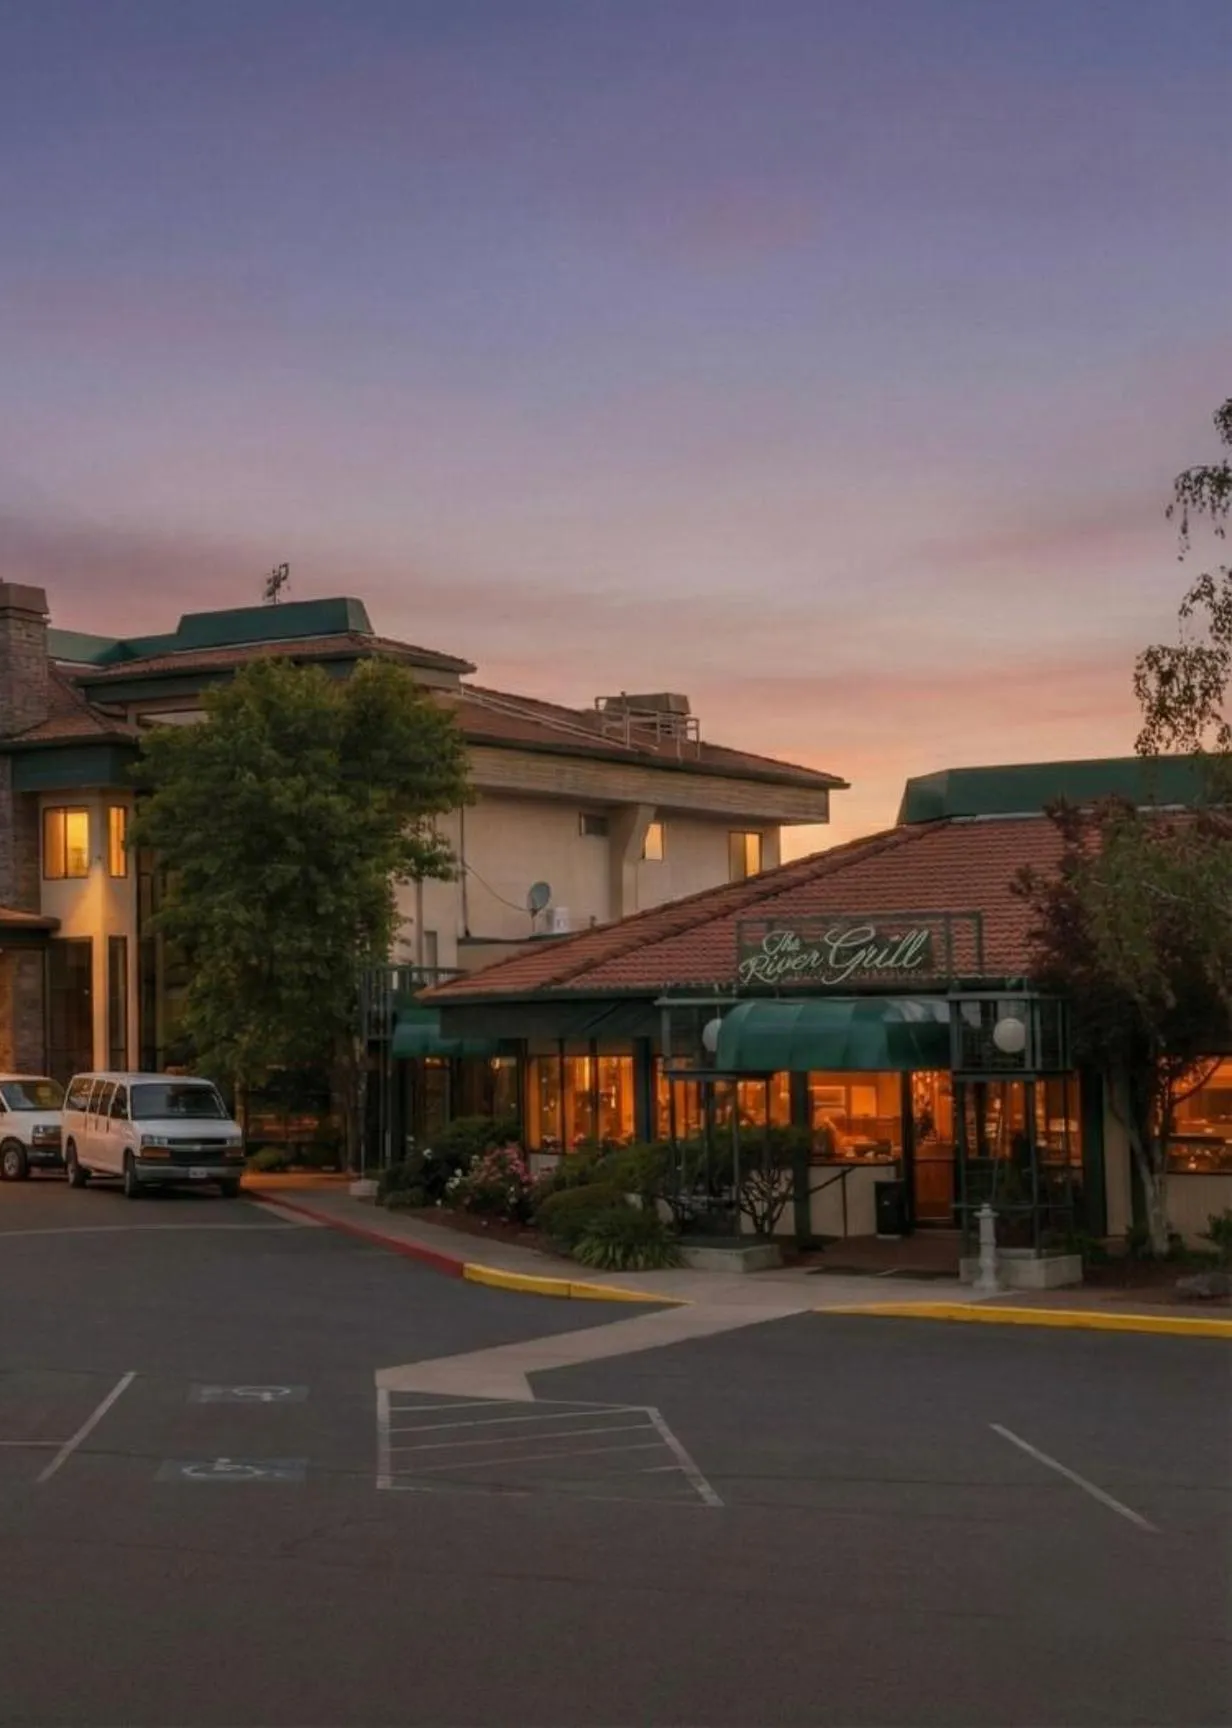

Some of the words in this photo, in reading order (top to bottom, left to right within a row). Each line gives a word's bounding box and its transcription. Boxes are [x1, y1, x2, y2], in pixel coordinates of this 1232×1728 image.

[762, 930, 801, 954] The
[822, 926, 929, 985] Grill
[738, 949, 824, 984] River
